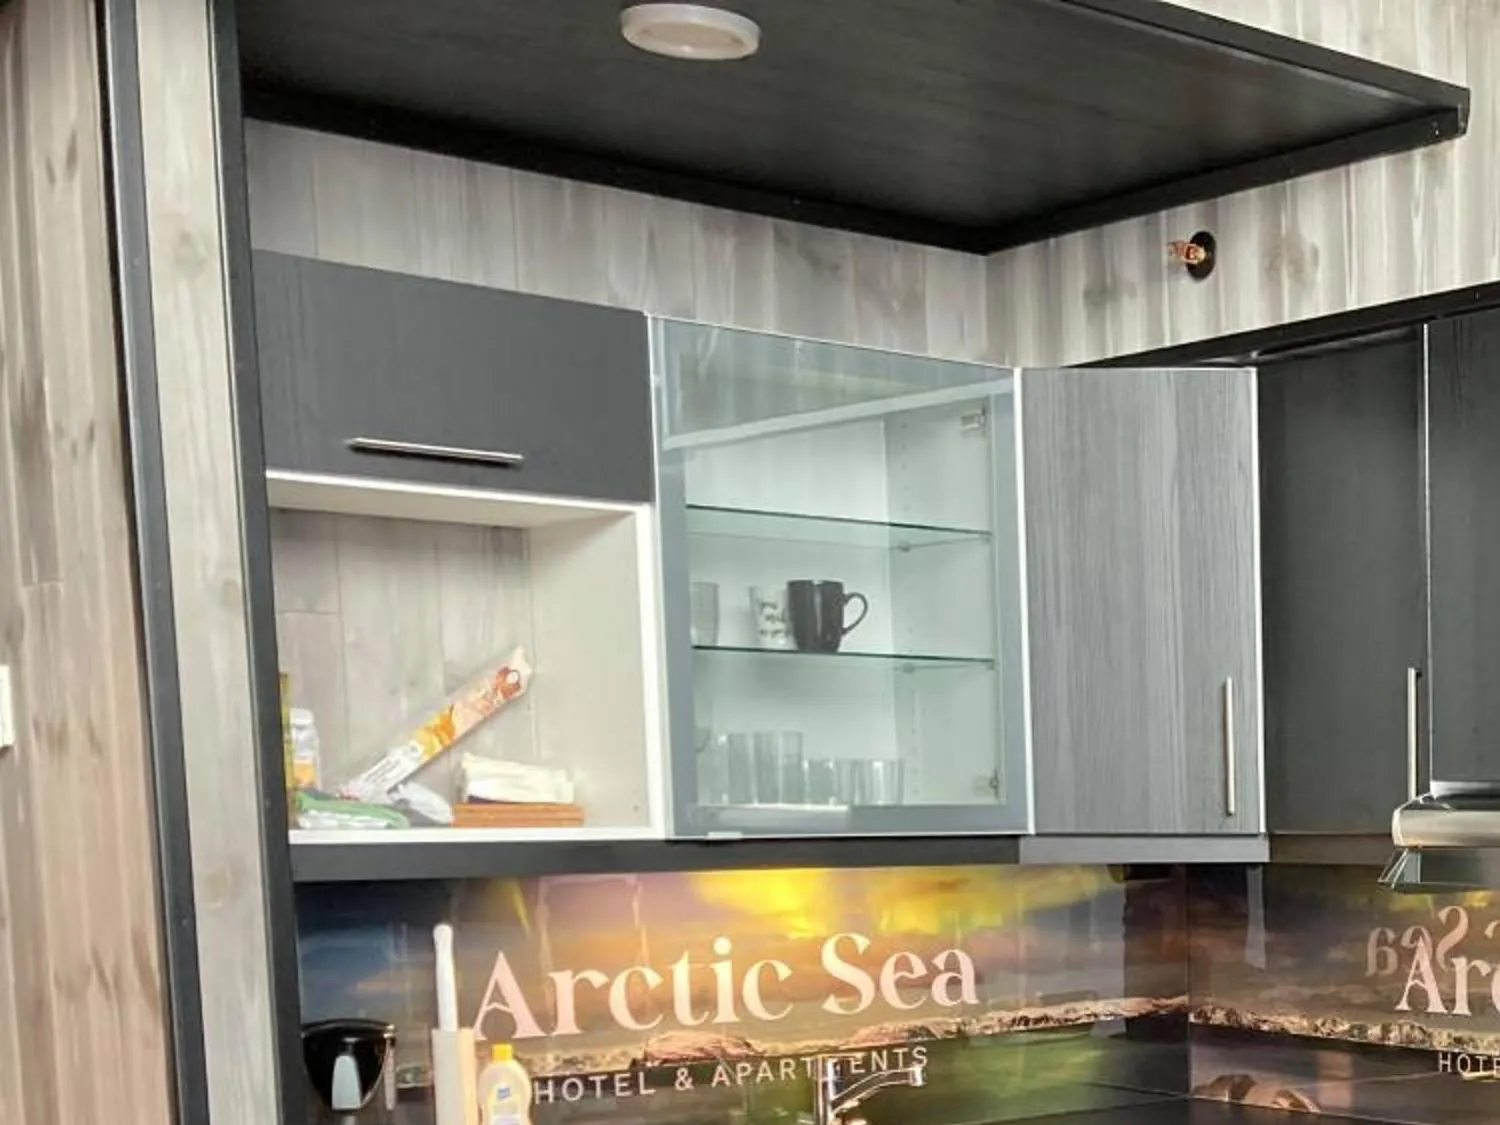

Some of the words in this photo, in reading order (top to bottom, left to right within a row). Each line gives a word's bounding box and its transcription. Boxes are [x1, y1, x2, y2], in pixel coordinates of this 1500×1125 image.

[473, 936, 794, 1041] Arctic
[821, 932, 979, 1015] Sea
[534, 1070, 657, 1105] HOTEL
[675, 1069, 694, 1092] &
[711, 1046, 928, 1088] APARTENTS
